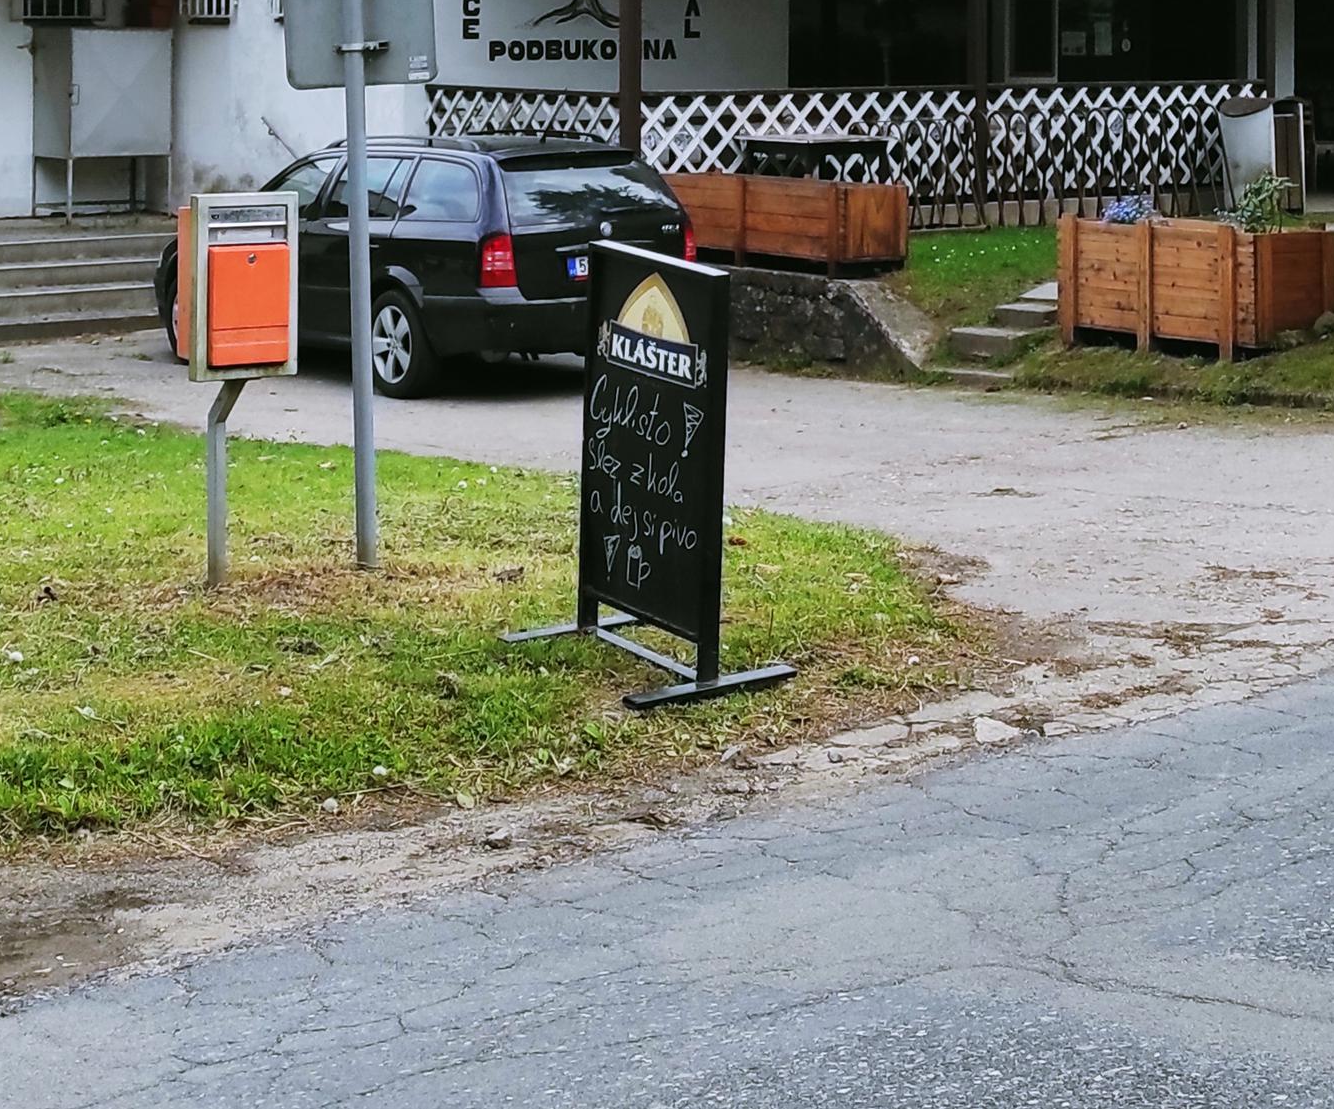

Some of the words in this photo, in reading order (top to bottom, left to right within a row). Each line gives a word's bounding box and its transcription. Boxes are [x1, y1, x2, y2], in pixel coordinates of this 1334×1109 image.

[488, 39, 678, 62] PODBUKONA
[611, 333, 693, 381] KLÁŠTER
[658, 514, 698, 556] pivo
